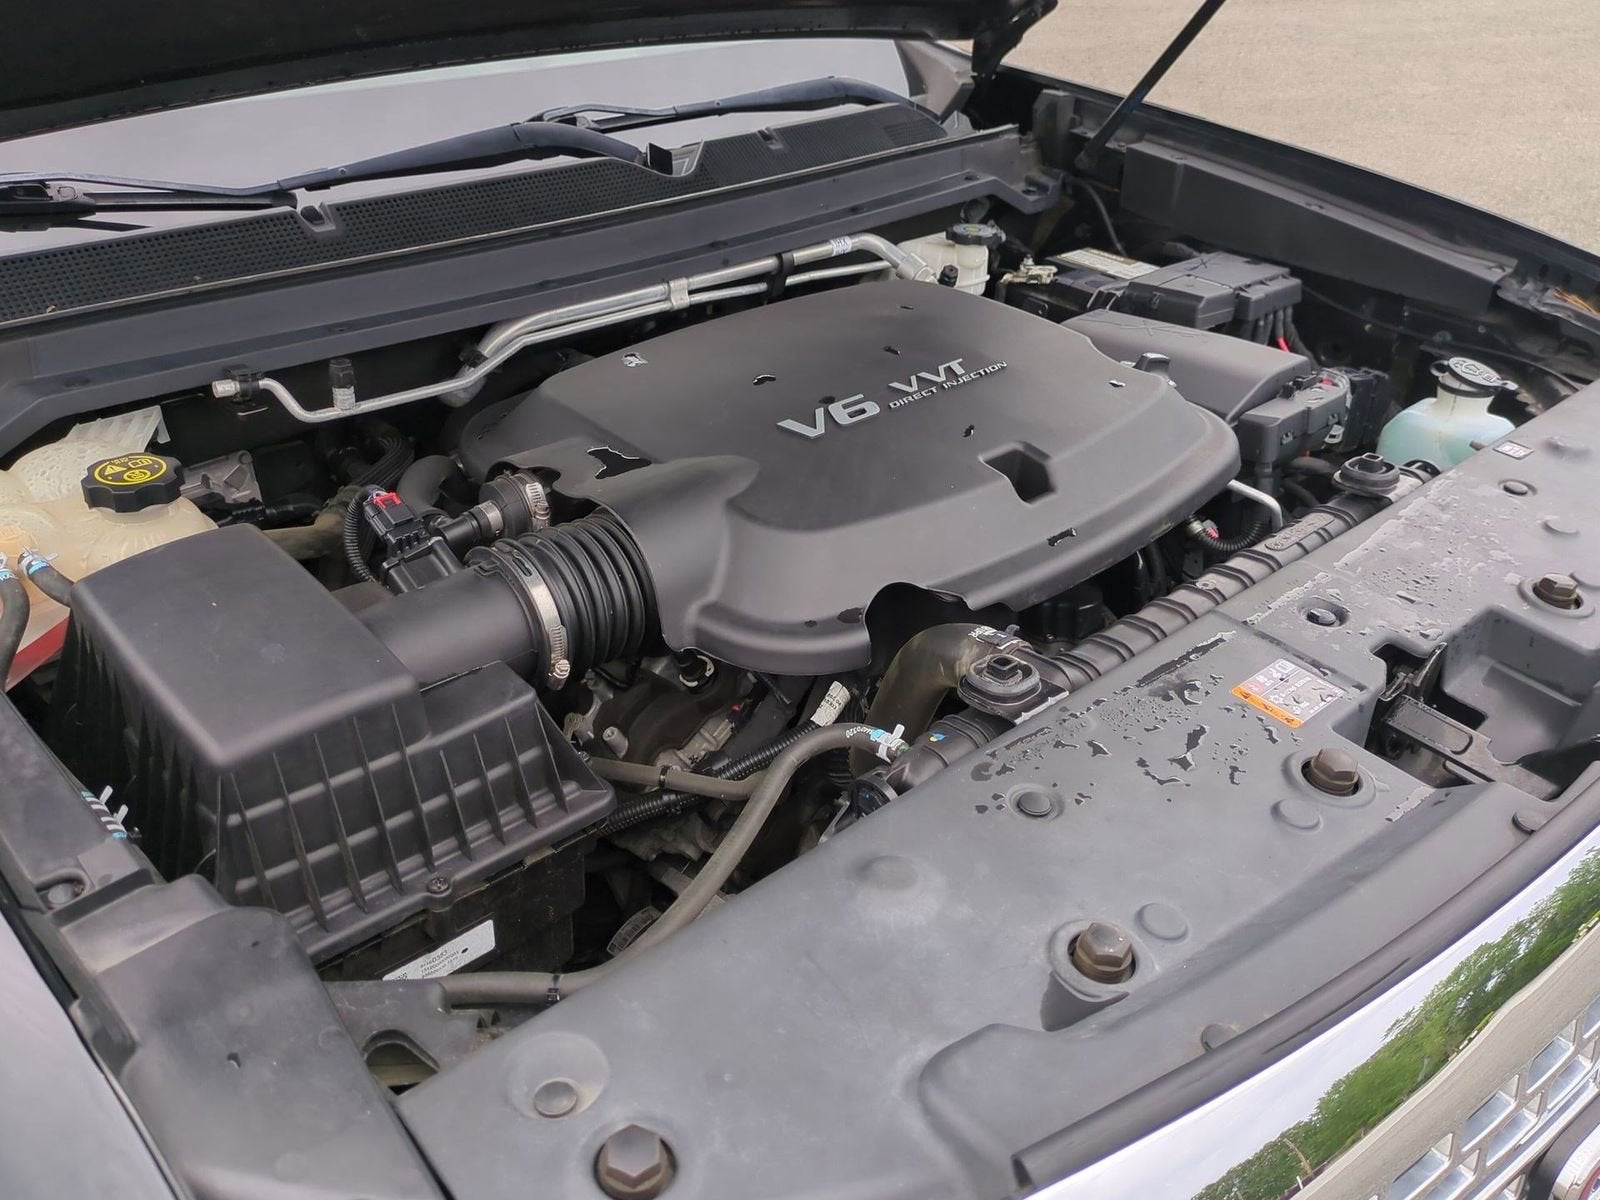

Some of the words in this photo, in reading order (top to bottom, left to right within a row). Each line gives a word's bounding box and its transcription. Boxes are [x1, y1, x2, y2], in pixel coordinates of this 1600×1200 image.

[776, 393, 881, 440] V6
[888, 358, 966, 393] VVT
[888, 386, 939, 410] DIRECT
[942, 360, 1008, 390] INJECTION
